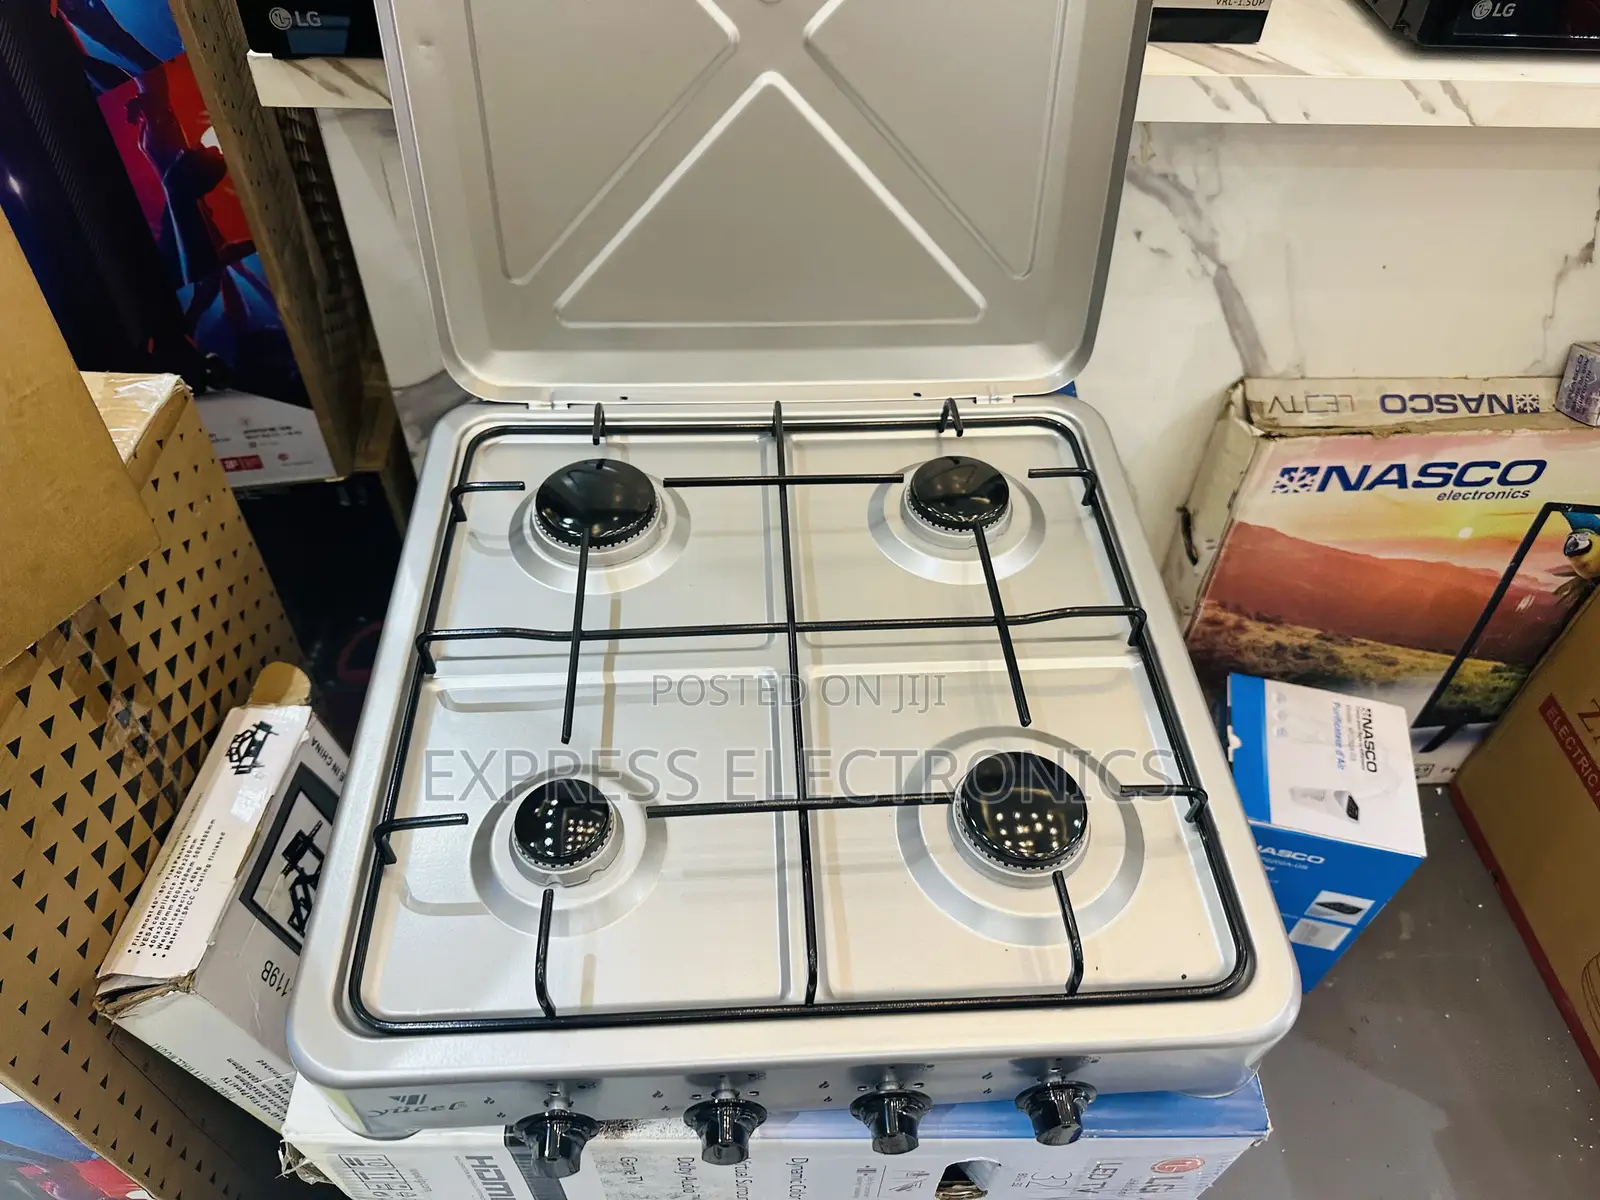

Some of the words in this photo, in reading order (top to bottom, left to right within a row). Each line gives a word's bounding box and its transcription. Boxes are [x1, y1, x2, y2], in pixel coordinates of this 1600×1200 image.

[294, 10, 322, 27] LG
[1492, 3, 1516, 17] LG
[1379, 394, 1514, 415] NASCO
[1316, 459, 1548, 492] NASCO
[1436, 488, 1531, 501] electronics
[310, 736, 334, 767] CHINA
[1362, 718, 1378, 773] NASCO
[1547, 704, 1599, 788] ELECTRIC
[261, 960, 292, 997] -119B
[1025, 1172, 1073, 1188] 32
[1139, 1175, 1184, 1194] LG
